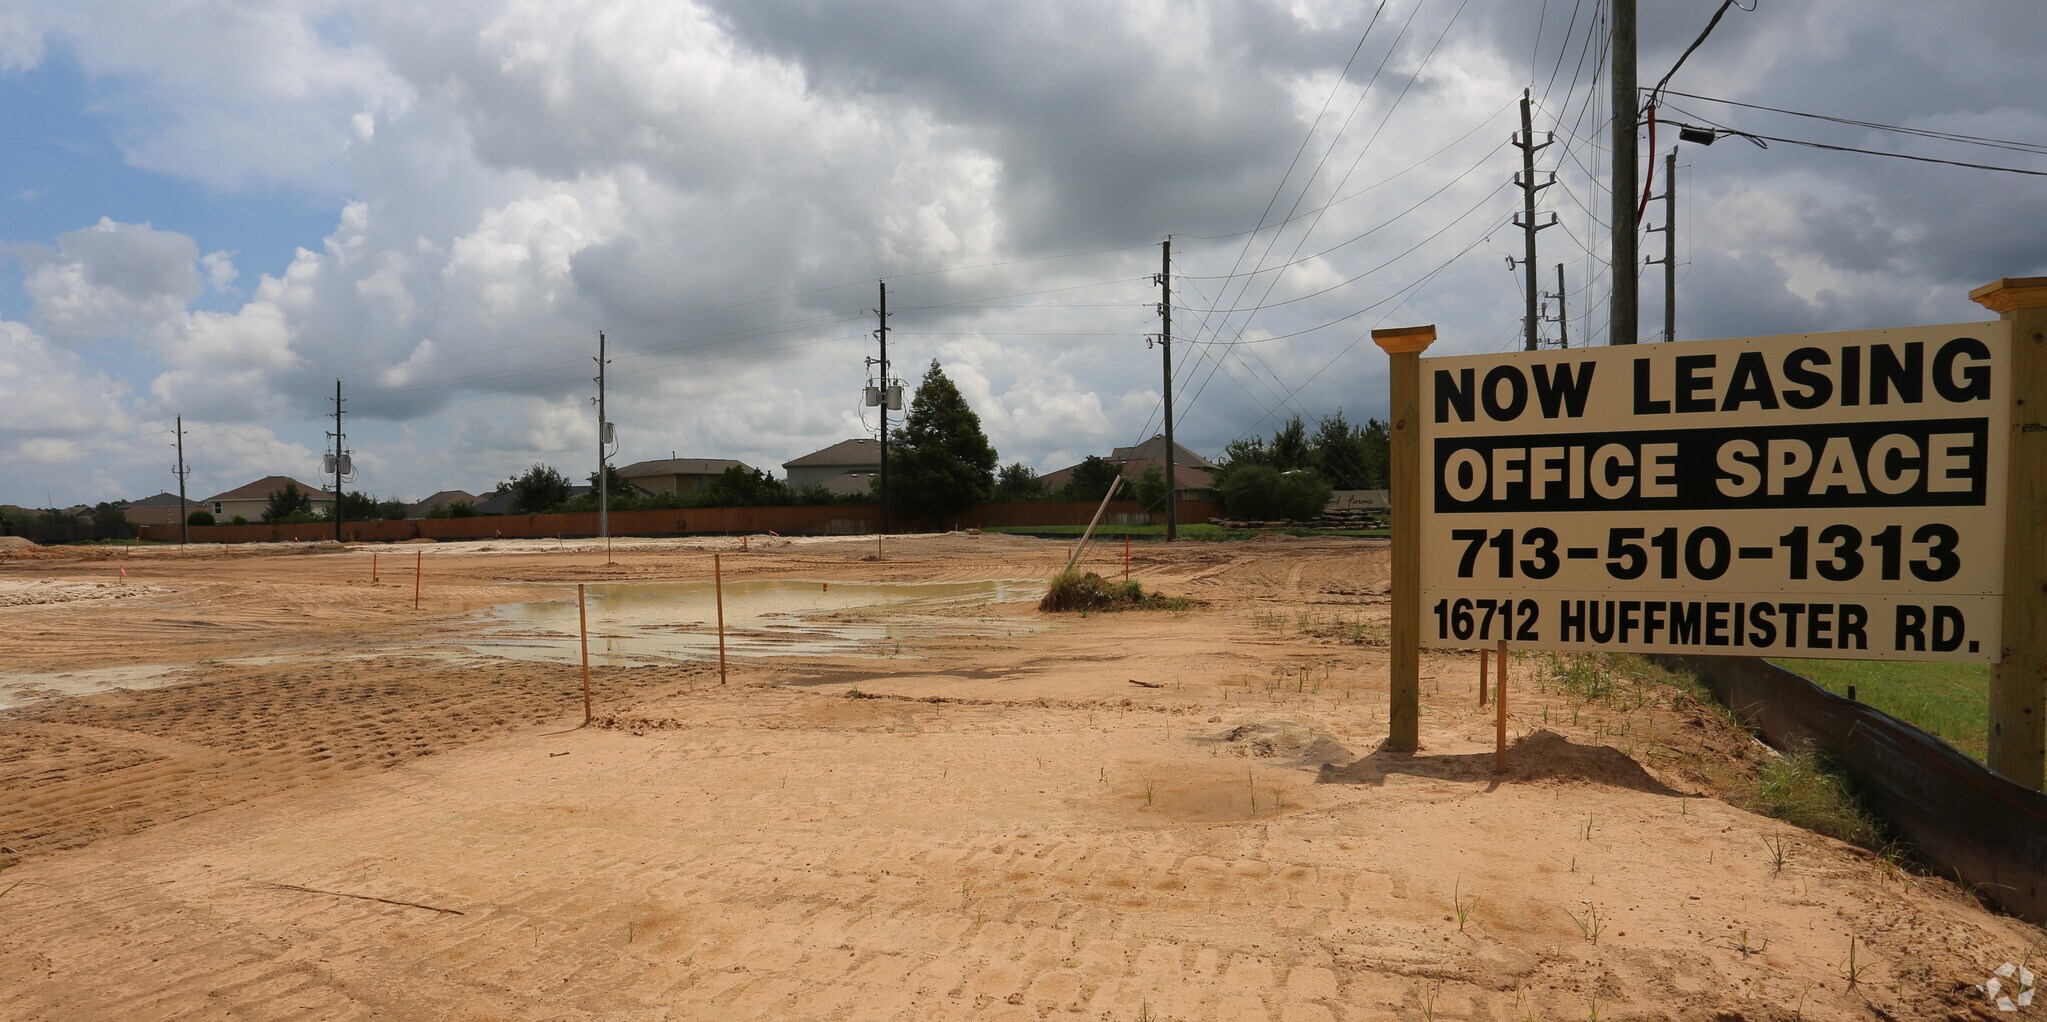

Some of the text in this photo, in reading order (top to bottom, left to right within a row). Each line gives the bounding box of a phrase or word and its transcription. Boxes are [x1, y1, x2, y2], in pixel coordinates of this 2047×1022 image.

[1434, 337, 1992, 424] NOW LEASING
[1444, 432, 1974, 502] OFFICE SPACE
[1451, 523, 1962, 583] 713-510-1313
[1433, 598, 1981, 654] 16712 HUFFMEISTER RD.
